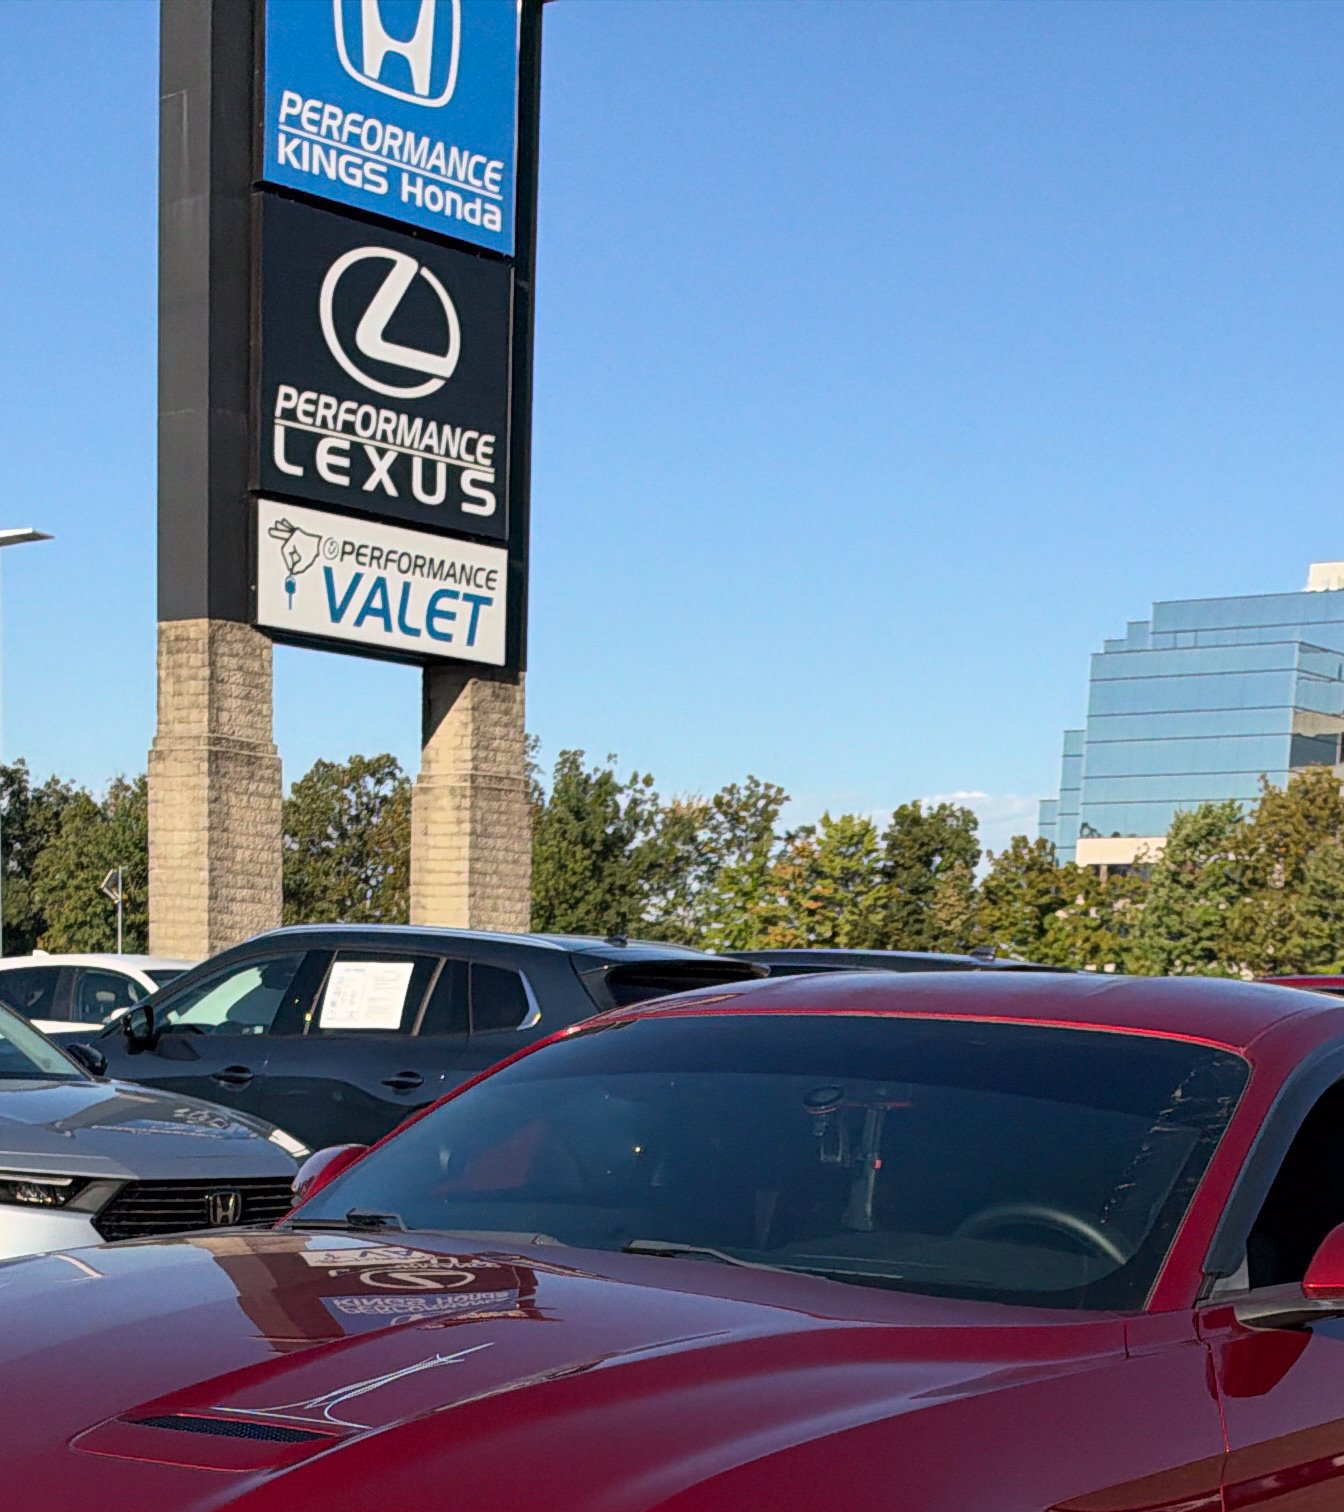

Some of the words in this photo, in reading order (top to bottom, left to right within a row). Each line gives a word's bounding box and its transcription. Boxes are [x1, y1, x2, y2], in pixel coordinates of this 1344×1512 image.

[277, 133, 389, 195] KINGS
[401, 172, 502, 233] Honda
[278, 90, 505, 193] PERFORMANCE
[274, 384, 496, 466] PERFORMANCE
[273, 425, 497, 517] LEXUS
[322, 565, 494, 647] VALET
[339, 540, 499, 591] PERFORMANCE
